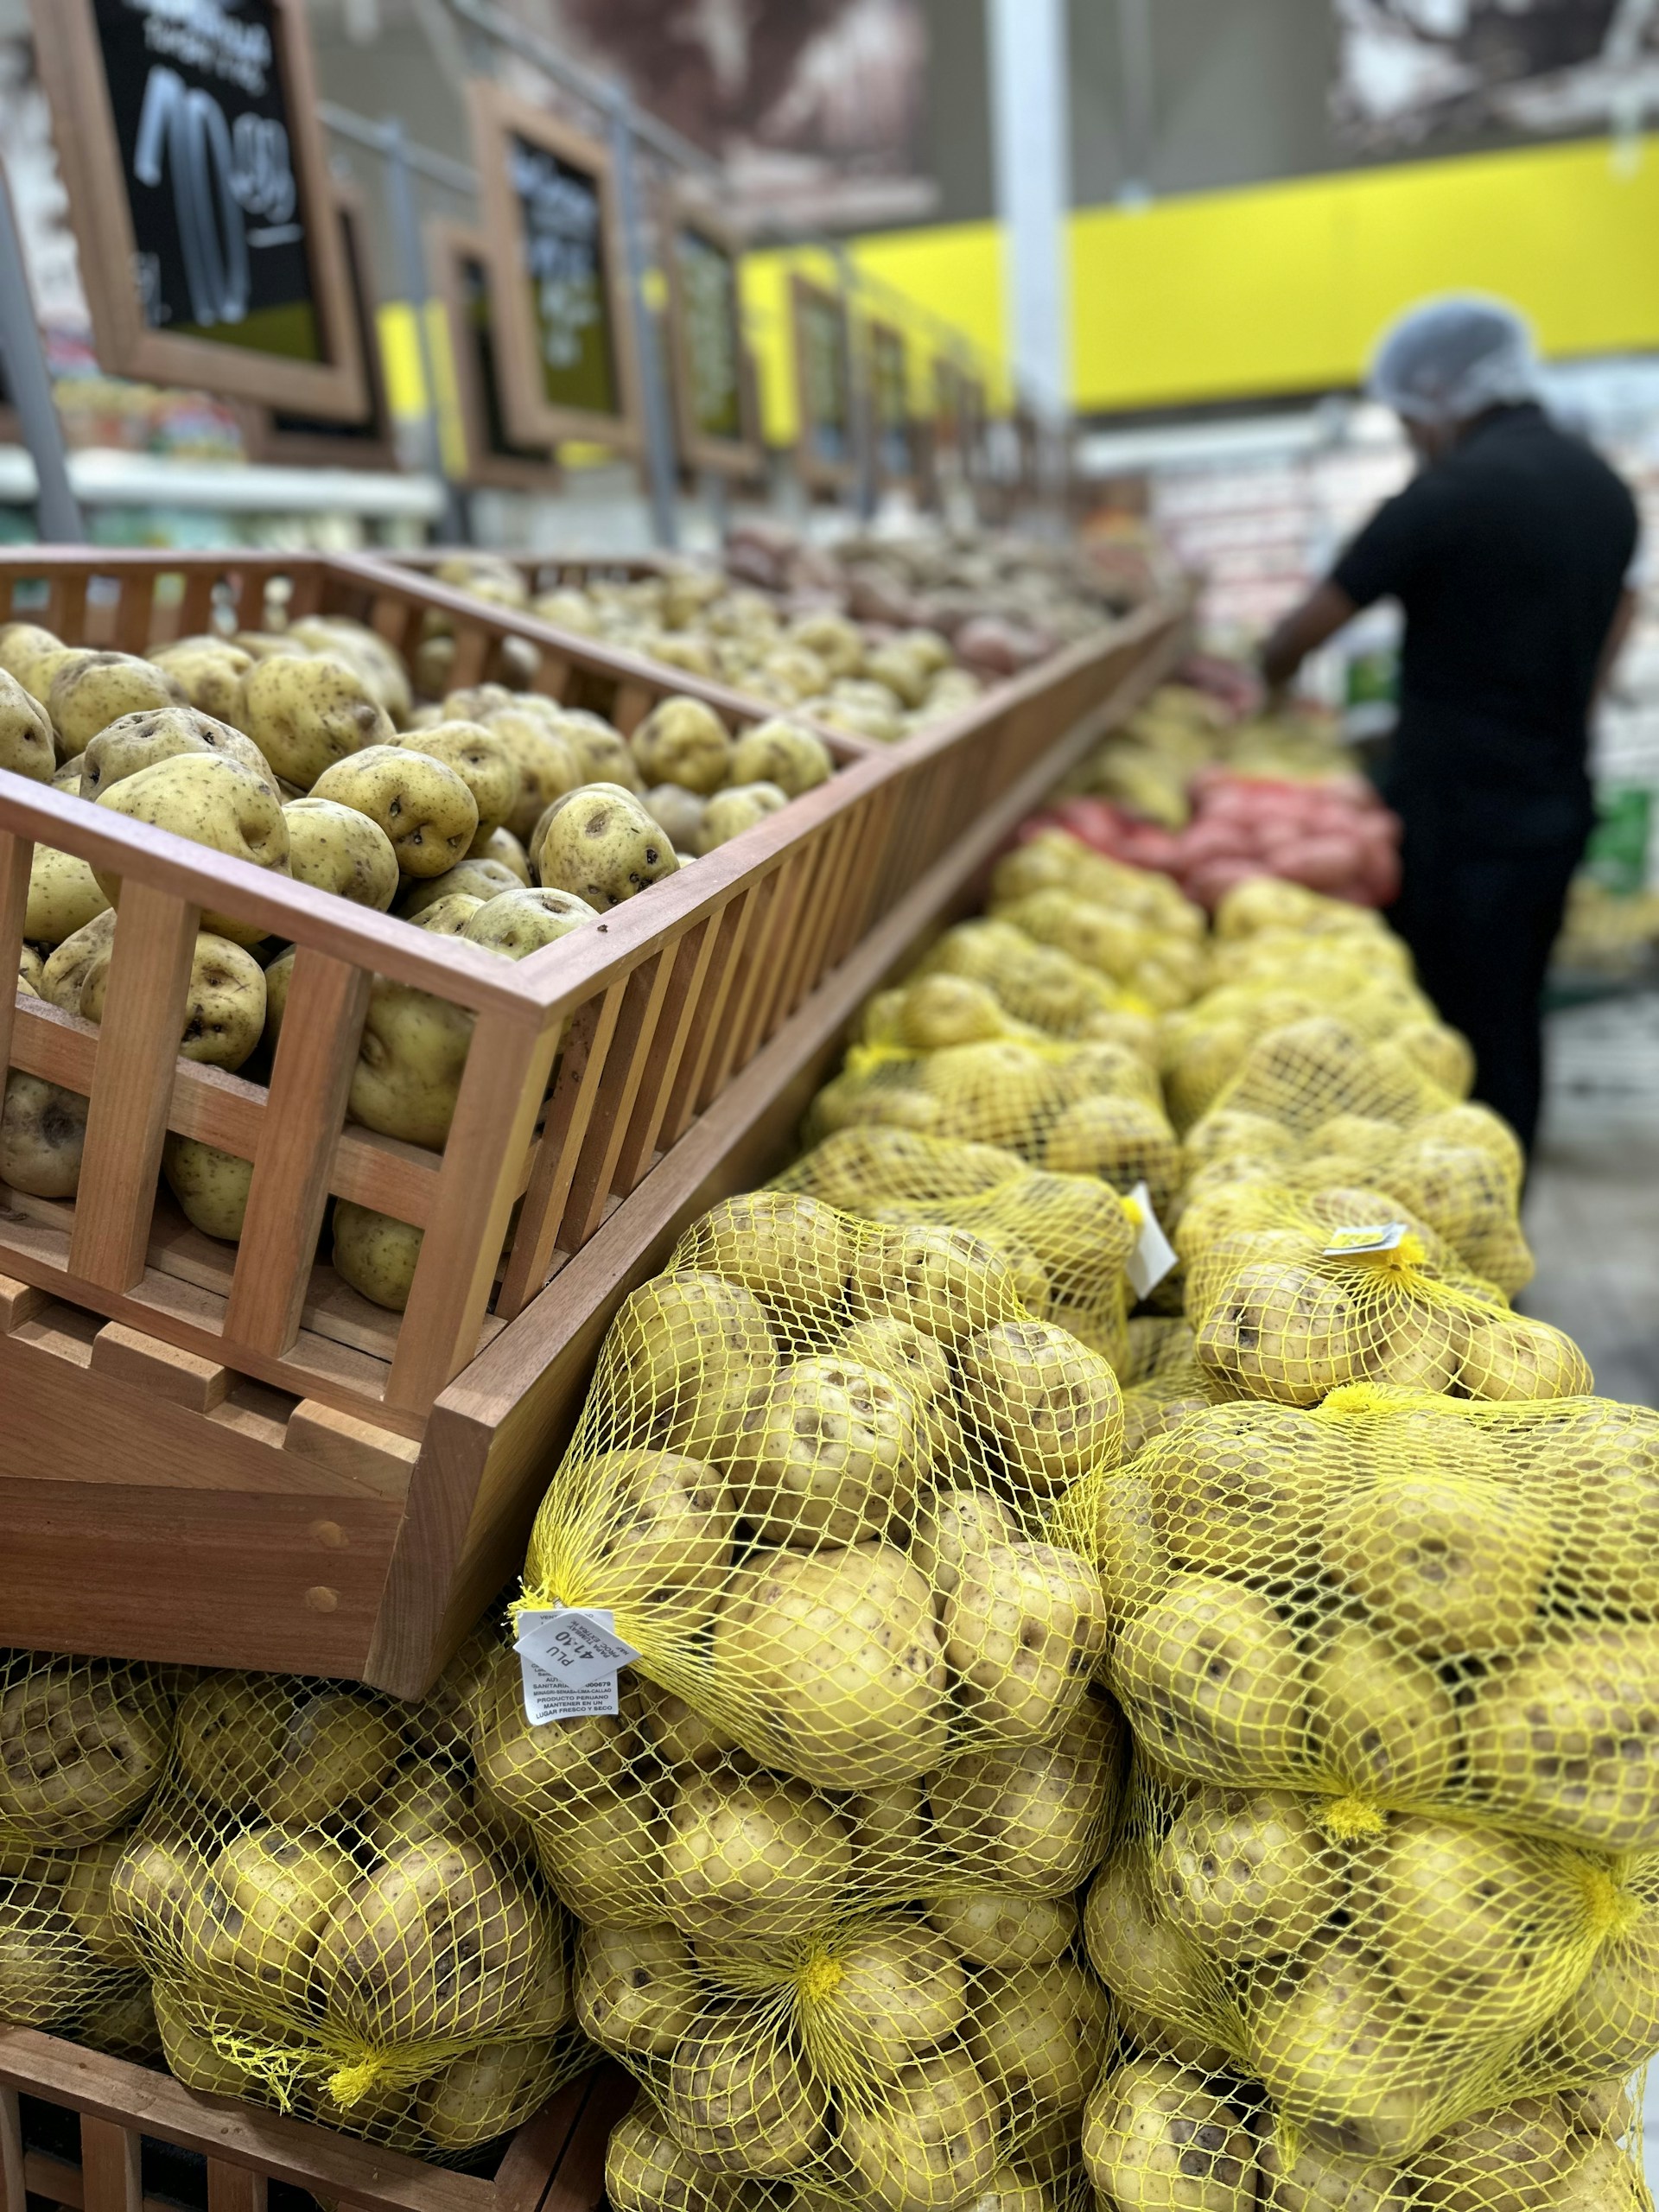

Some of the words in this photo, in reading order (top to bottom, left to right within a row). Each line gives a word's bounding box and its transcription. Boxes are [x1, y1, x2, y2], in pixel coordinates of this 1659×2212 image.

[567, 1625, 594, 1645] TUMBAY
[579, 1625, 601, 1643] EXTRA
[546, 1646, 575, 1667] PLU
[593, 1643, 610, 1658] PAPA
[537, 1695, 575, 1704] PRODUCTO
[536, 1709, 558, 1719] LUGAR
